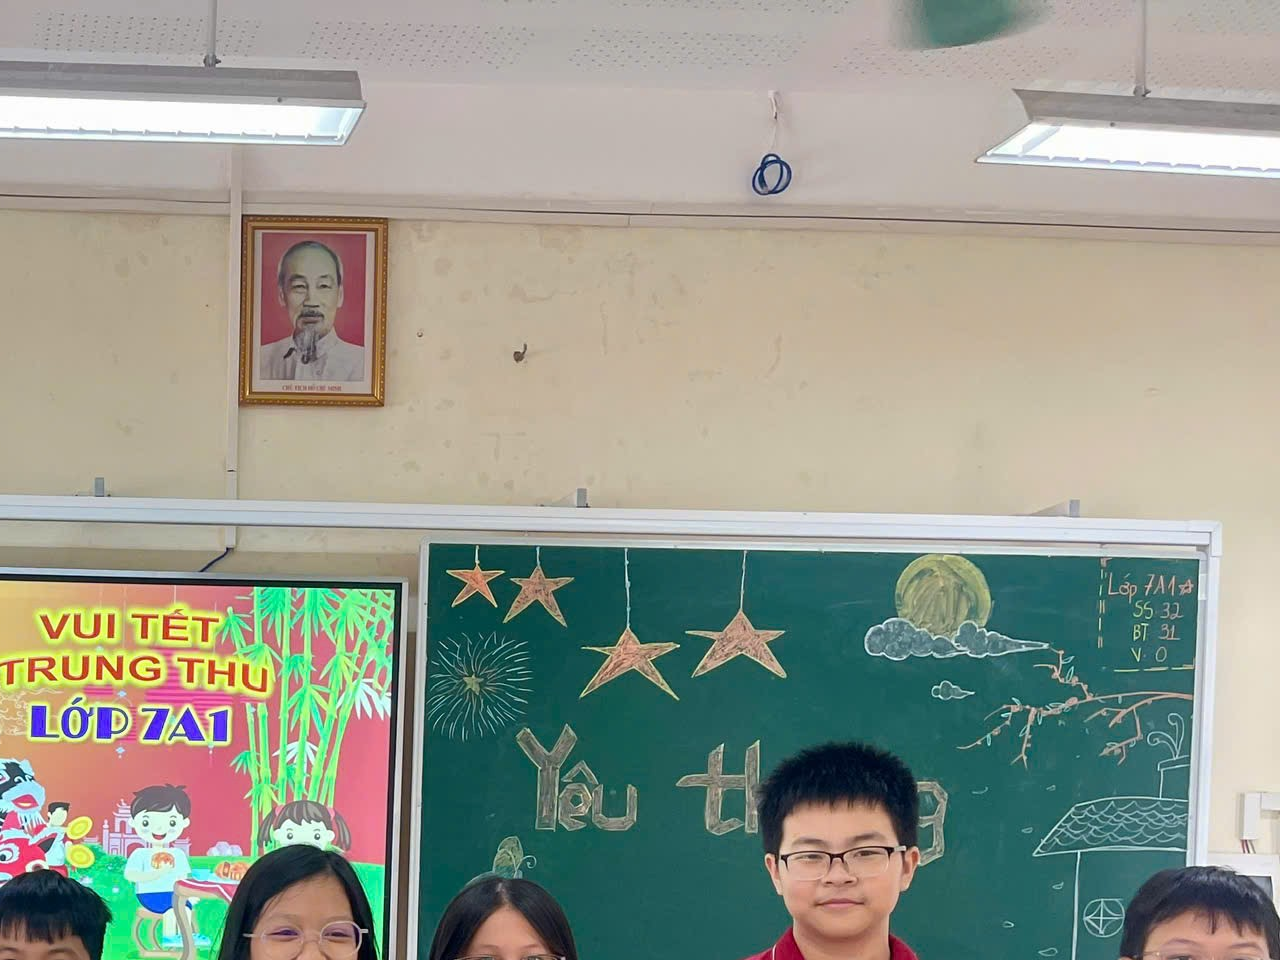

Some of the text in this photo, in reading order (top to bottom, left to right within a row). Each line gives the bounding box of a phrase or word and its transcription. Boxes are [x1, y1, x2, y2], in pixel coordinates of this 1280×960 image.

[40, 609, 220, 643] VUI TẾT
[177, 657, 268, 693] THU
[30, 697, 229, 742] LỚP 7A1
[516, 724, 638, 832] Yêu
